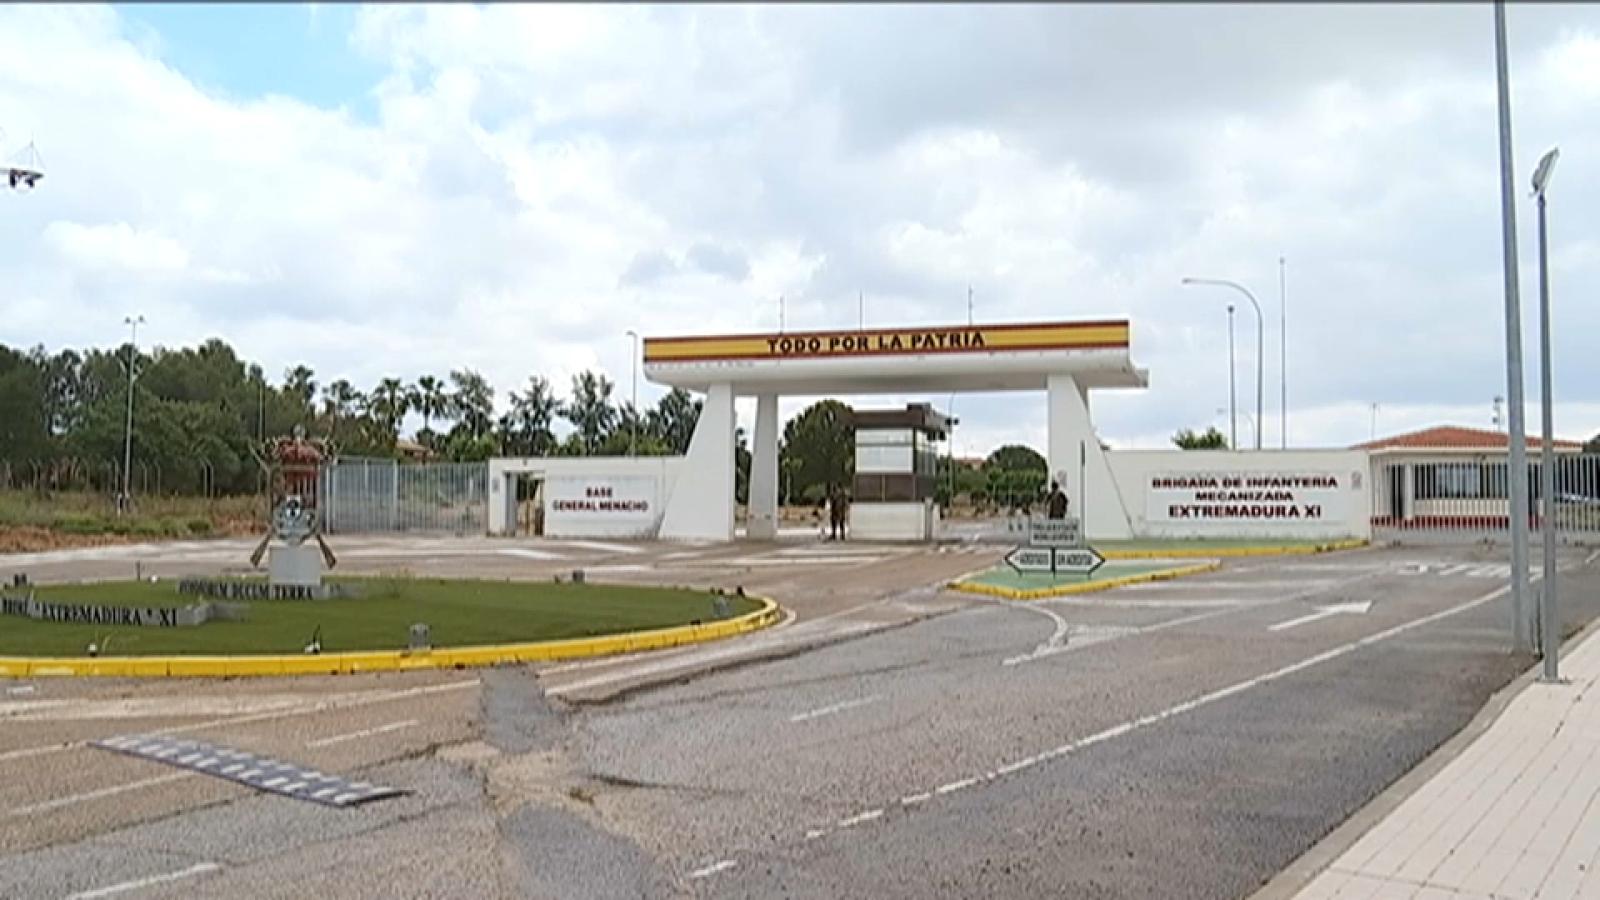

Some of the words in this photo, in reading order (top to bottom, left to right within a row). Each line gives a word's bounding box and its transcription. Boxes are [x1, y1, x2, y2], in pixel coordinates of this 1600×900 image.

[767, 337, 821, 354] TODO
[829, 335, 869, 351] POR
[879, 334, 903, 350] LA
[911, 332, 985, 348] PATRIA
[1152, 477, 1218, 489] BRIGADA
[1222, 477, 1243, 488] DE
[1247, 477, 1338, 488] INFANTERIA
[586, 487, 612, 498] BASE
[1195, 491, 1294, 501] MECANIZADA
[553, 500, 597, 512] GENERAL
[599, 500, 649, 512] MENACHO
[1168, 504, 1300, 518] EXTREMADURA
[1304, 504, 1322, 518] XI
[159, 607, 177, 627] XI
